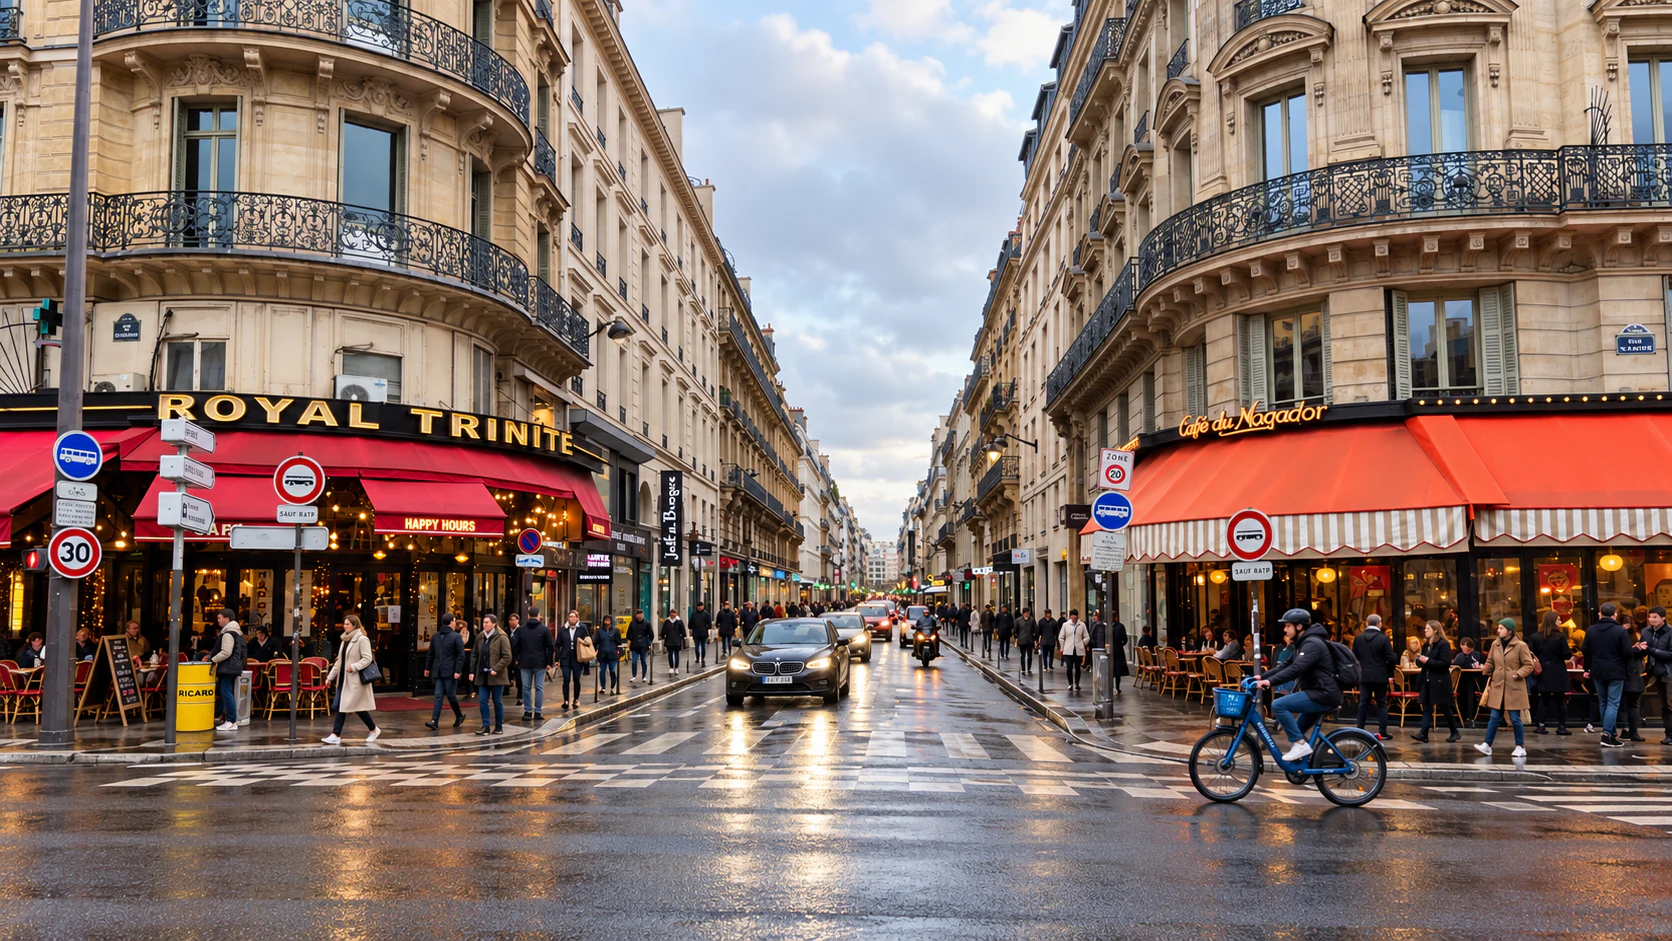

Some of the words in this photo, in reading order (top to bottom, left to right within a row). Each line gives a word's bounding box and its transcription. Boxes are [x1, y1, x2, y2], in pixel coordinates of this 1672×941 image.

[158, 394, 379, 429] ROYAL
[1179, 415, 1209, 439] Café
[1212, 410, 1234, 431] du
[1106, 453, 1128, 462] ZONE
[1110, 470, 1121, 478] 20
[405, 518, 439, 530] HAPPY
[441, 519, 475, 531] HOURS
[61, 542, 90, 563] 30
